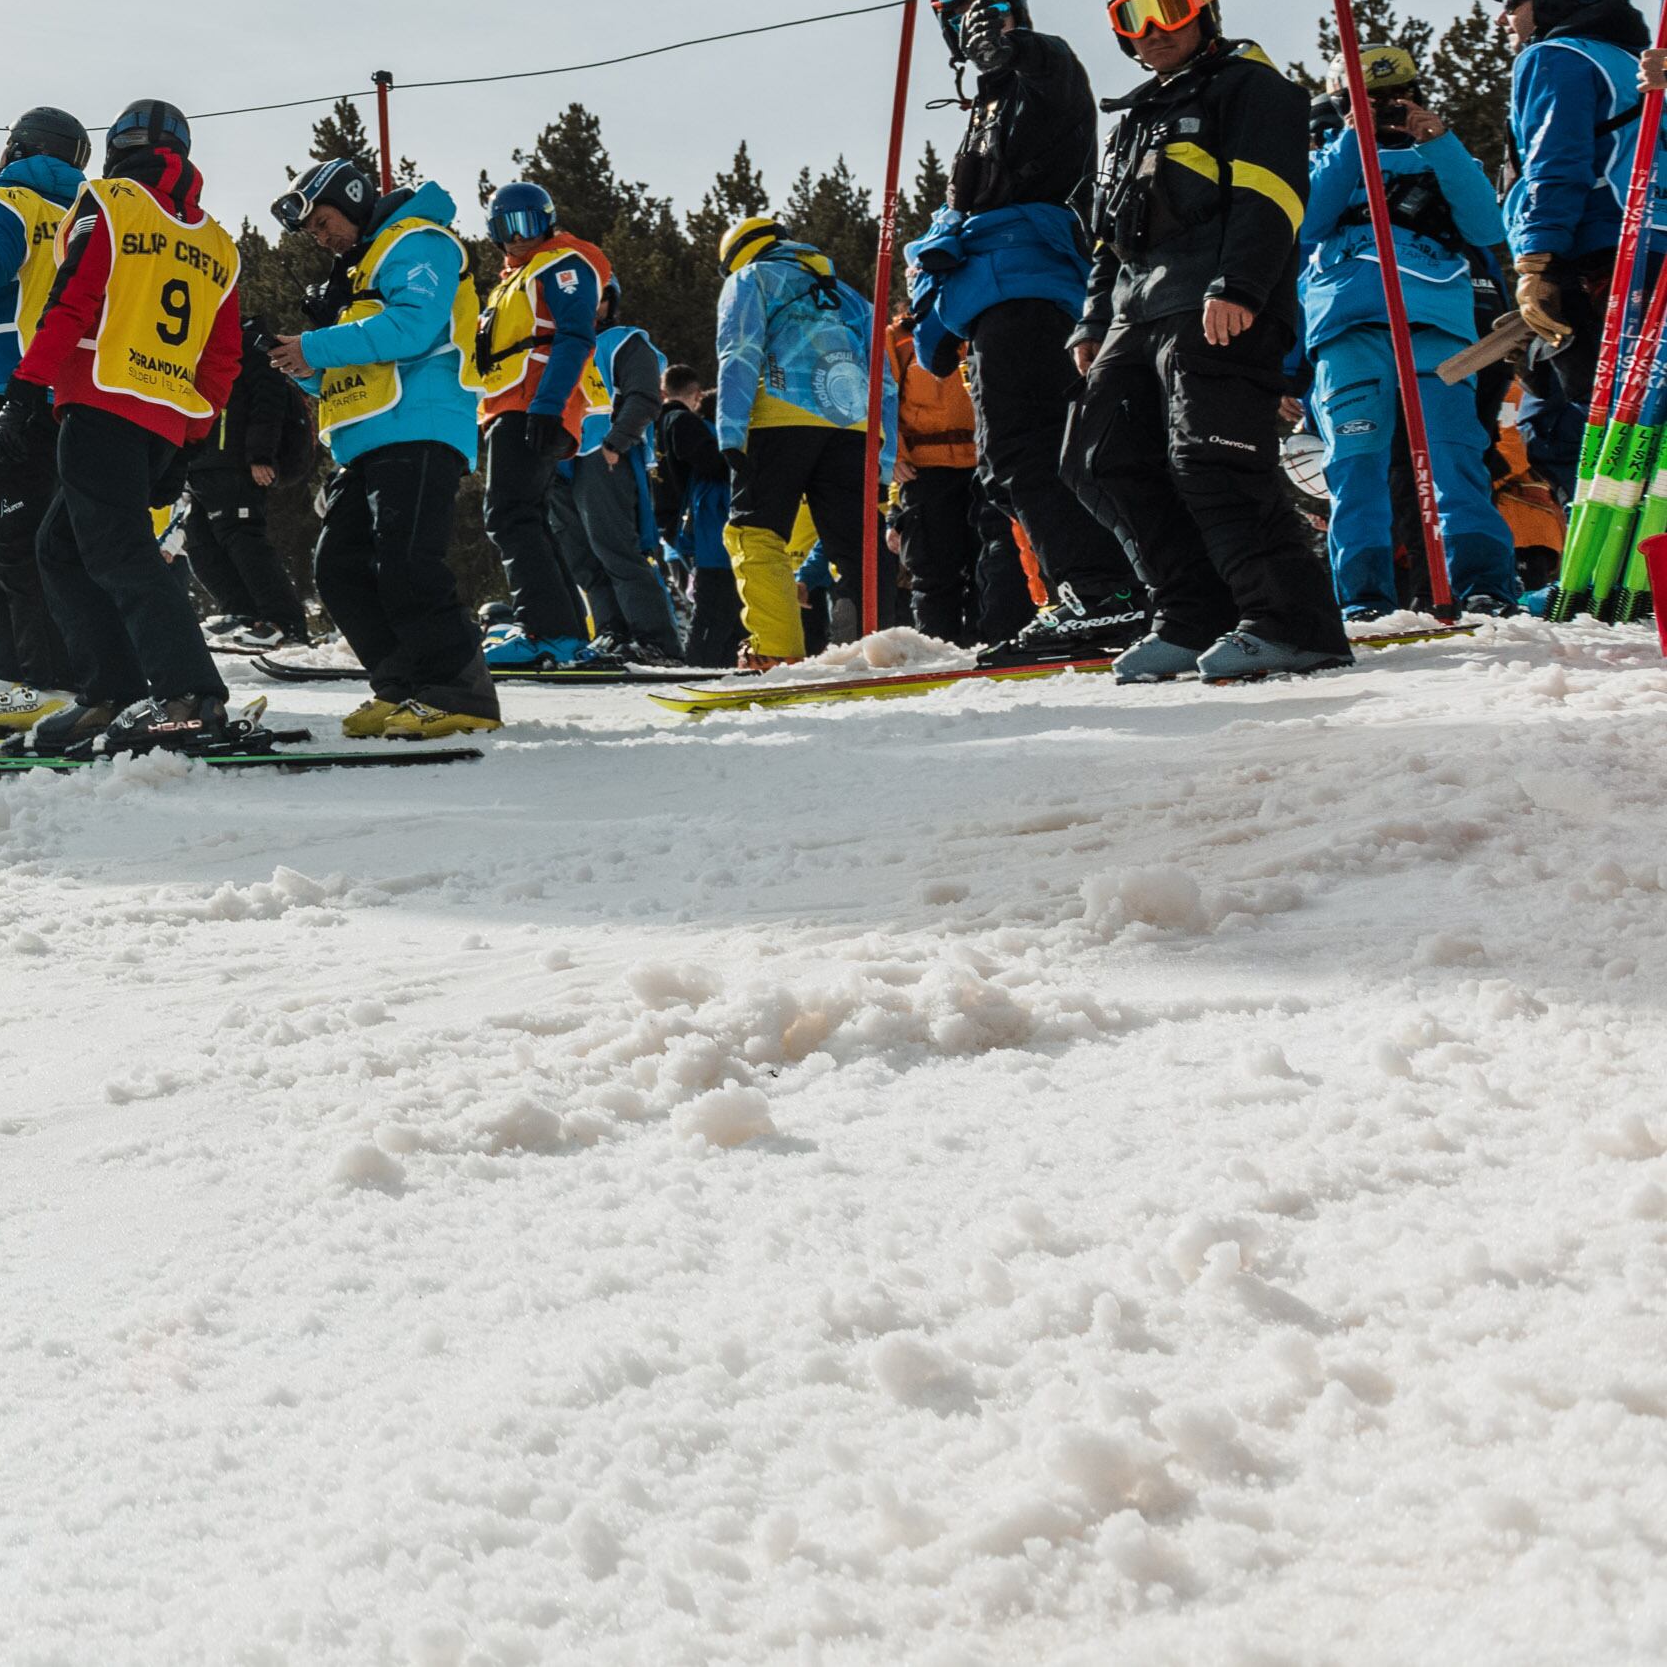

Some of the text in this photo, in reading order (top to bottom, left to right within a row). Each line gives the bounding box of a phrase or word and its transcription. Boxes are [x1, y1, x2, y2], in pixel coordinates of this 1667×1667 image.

[122, 232, 167, 255] SLIP
[156, 278, 192, 346] 9
[1342, 422, 1371, 435] Ford
[1608, 426, 1627, 476] LISKI
[1629, 430, 1650, 480] LISKI
[1417, 456, 1432, 523] LISKI
[1056, 610, 1145, 634] NORDICA
[147, 719, 203, 733] HEAD
